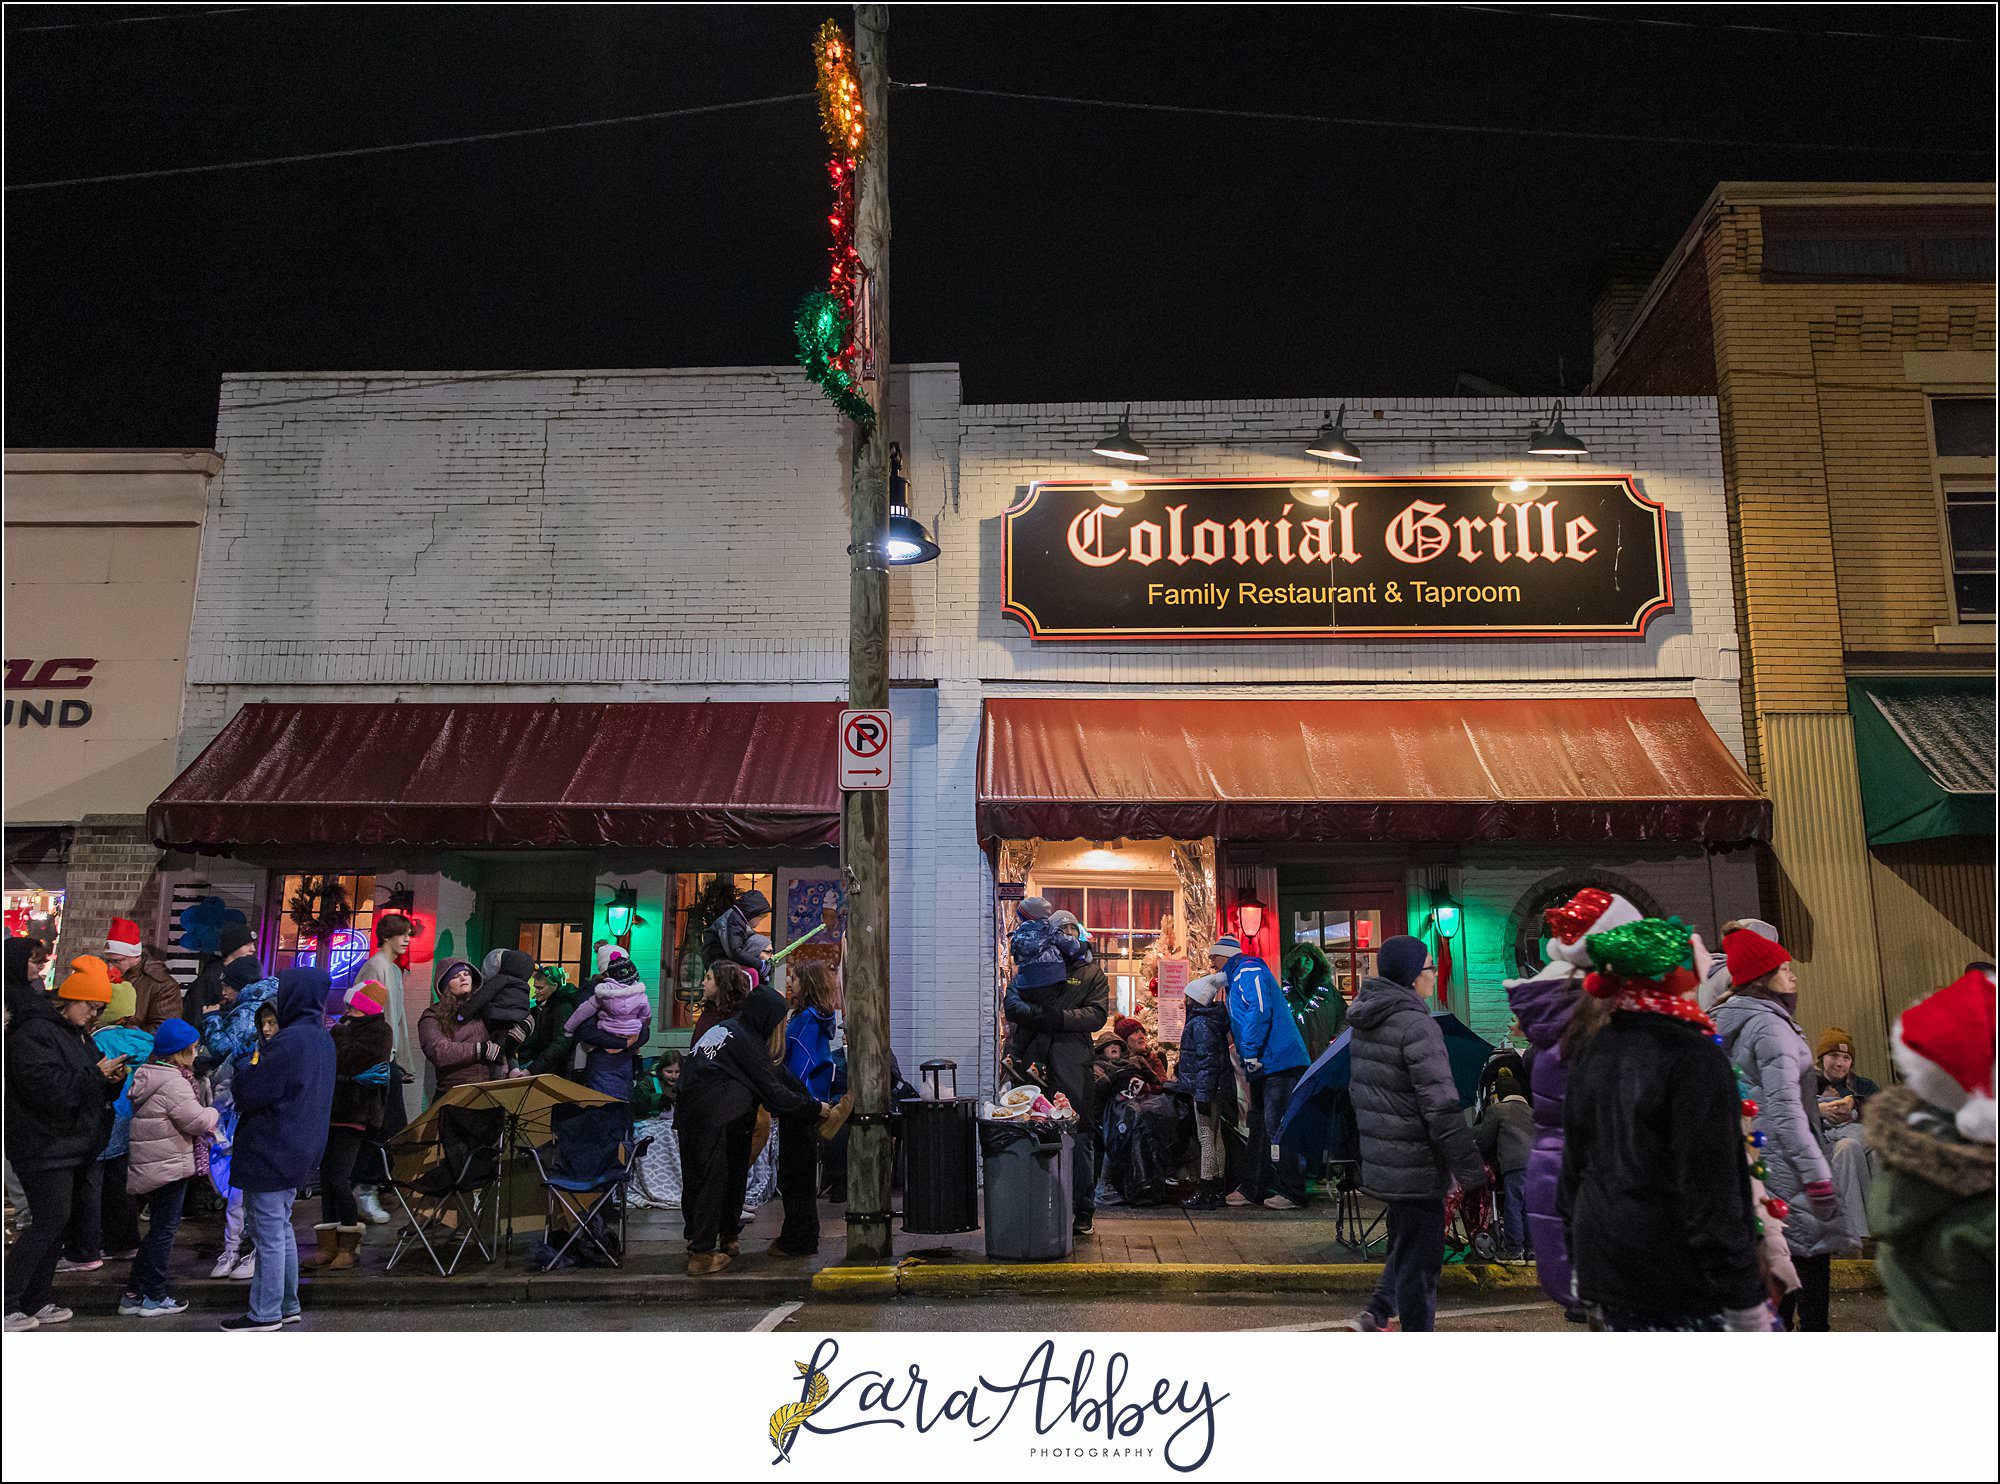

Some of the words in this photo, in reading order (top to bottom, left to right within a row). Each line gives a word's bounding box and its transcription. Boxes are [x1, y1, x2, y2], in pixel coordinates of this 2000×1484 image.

[1066, 503, 1362, 567] Colonial
[1385, 499, 1599, 564] Grille
[1148, 583, 1230, 610] Family
[1239, 579, 1377, 606] Restaurant
[1384, 581, 1404, 603] &
[1410, 581, 1521, 608] Taproom
